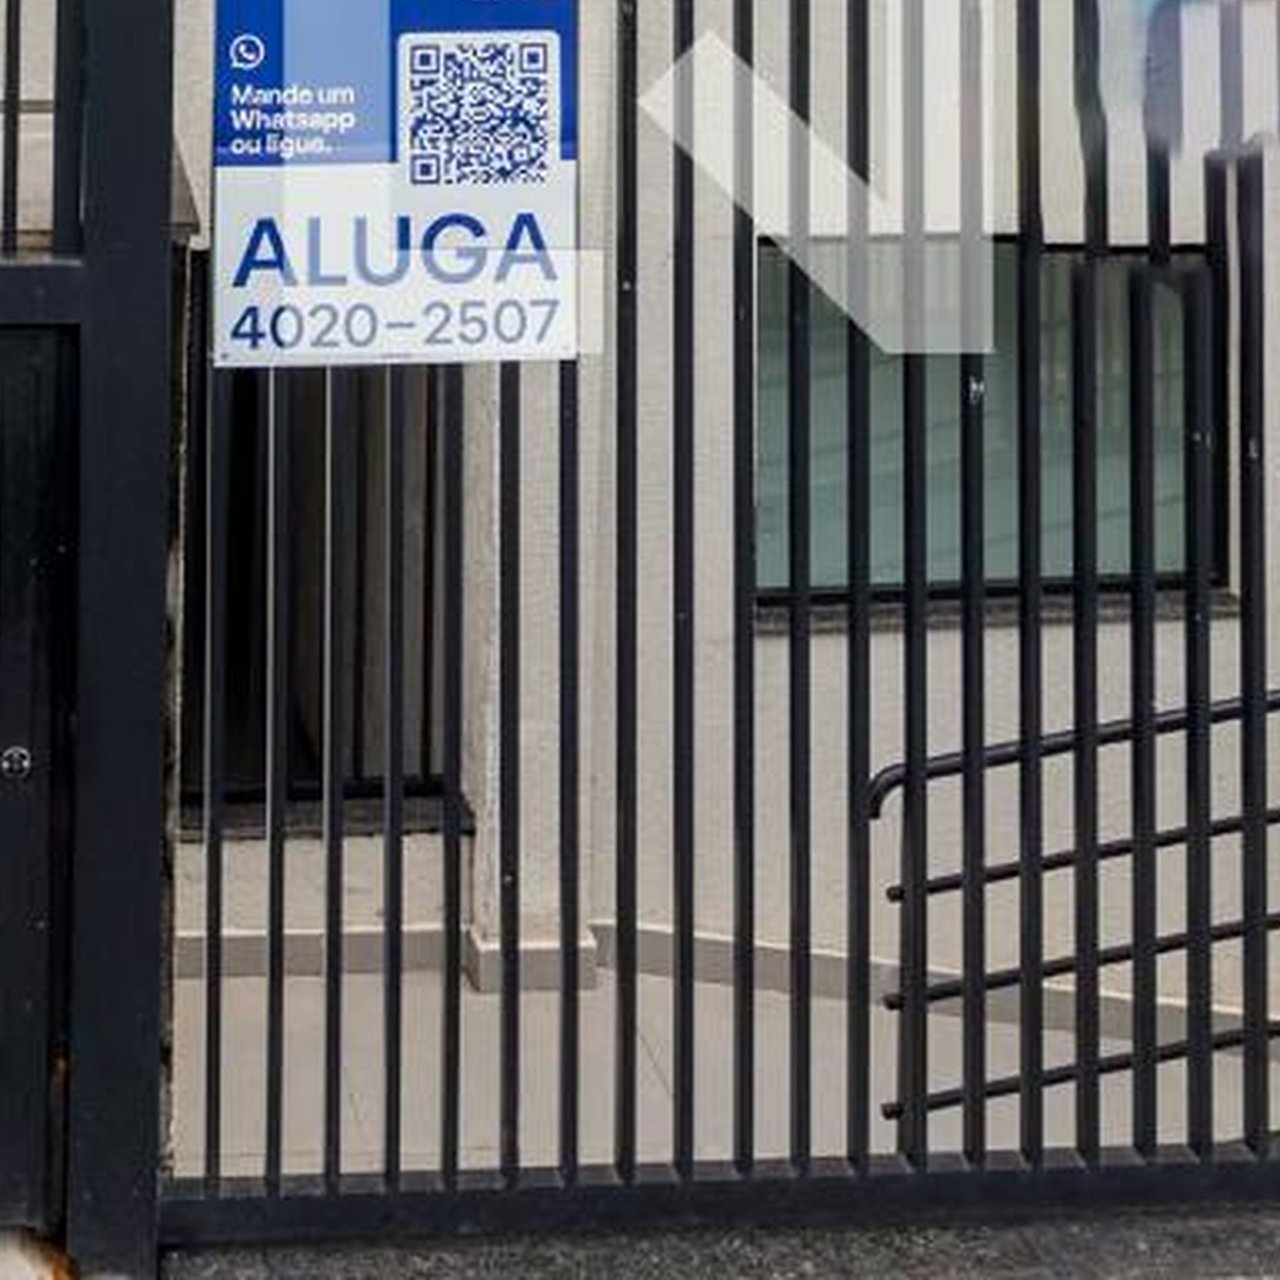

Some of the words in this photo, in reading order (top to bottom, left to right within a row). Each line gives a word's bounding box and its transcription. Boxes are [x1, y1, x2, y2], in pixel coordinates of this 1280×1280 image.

[231, 84, 314, 104] Mande
[317, 87, 355, 104] um
[230, 109, 356, 134] Whatsapp
[231, 138, 261, 155] ou
[232, 212, 559, 287] ALUGA
[231, 299, 561, 349] 4020-2507
